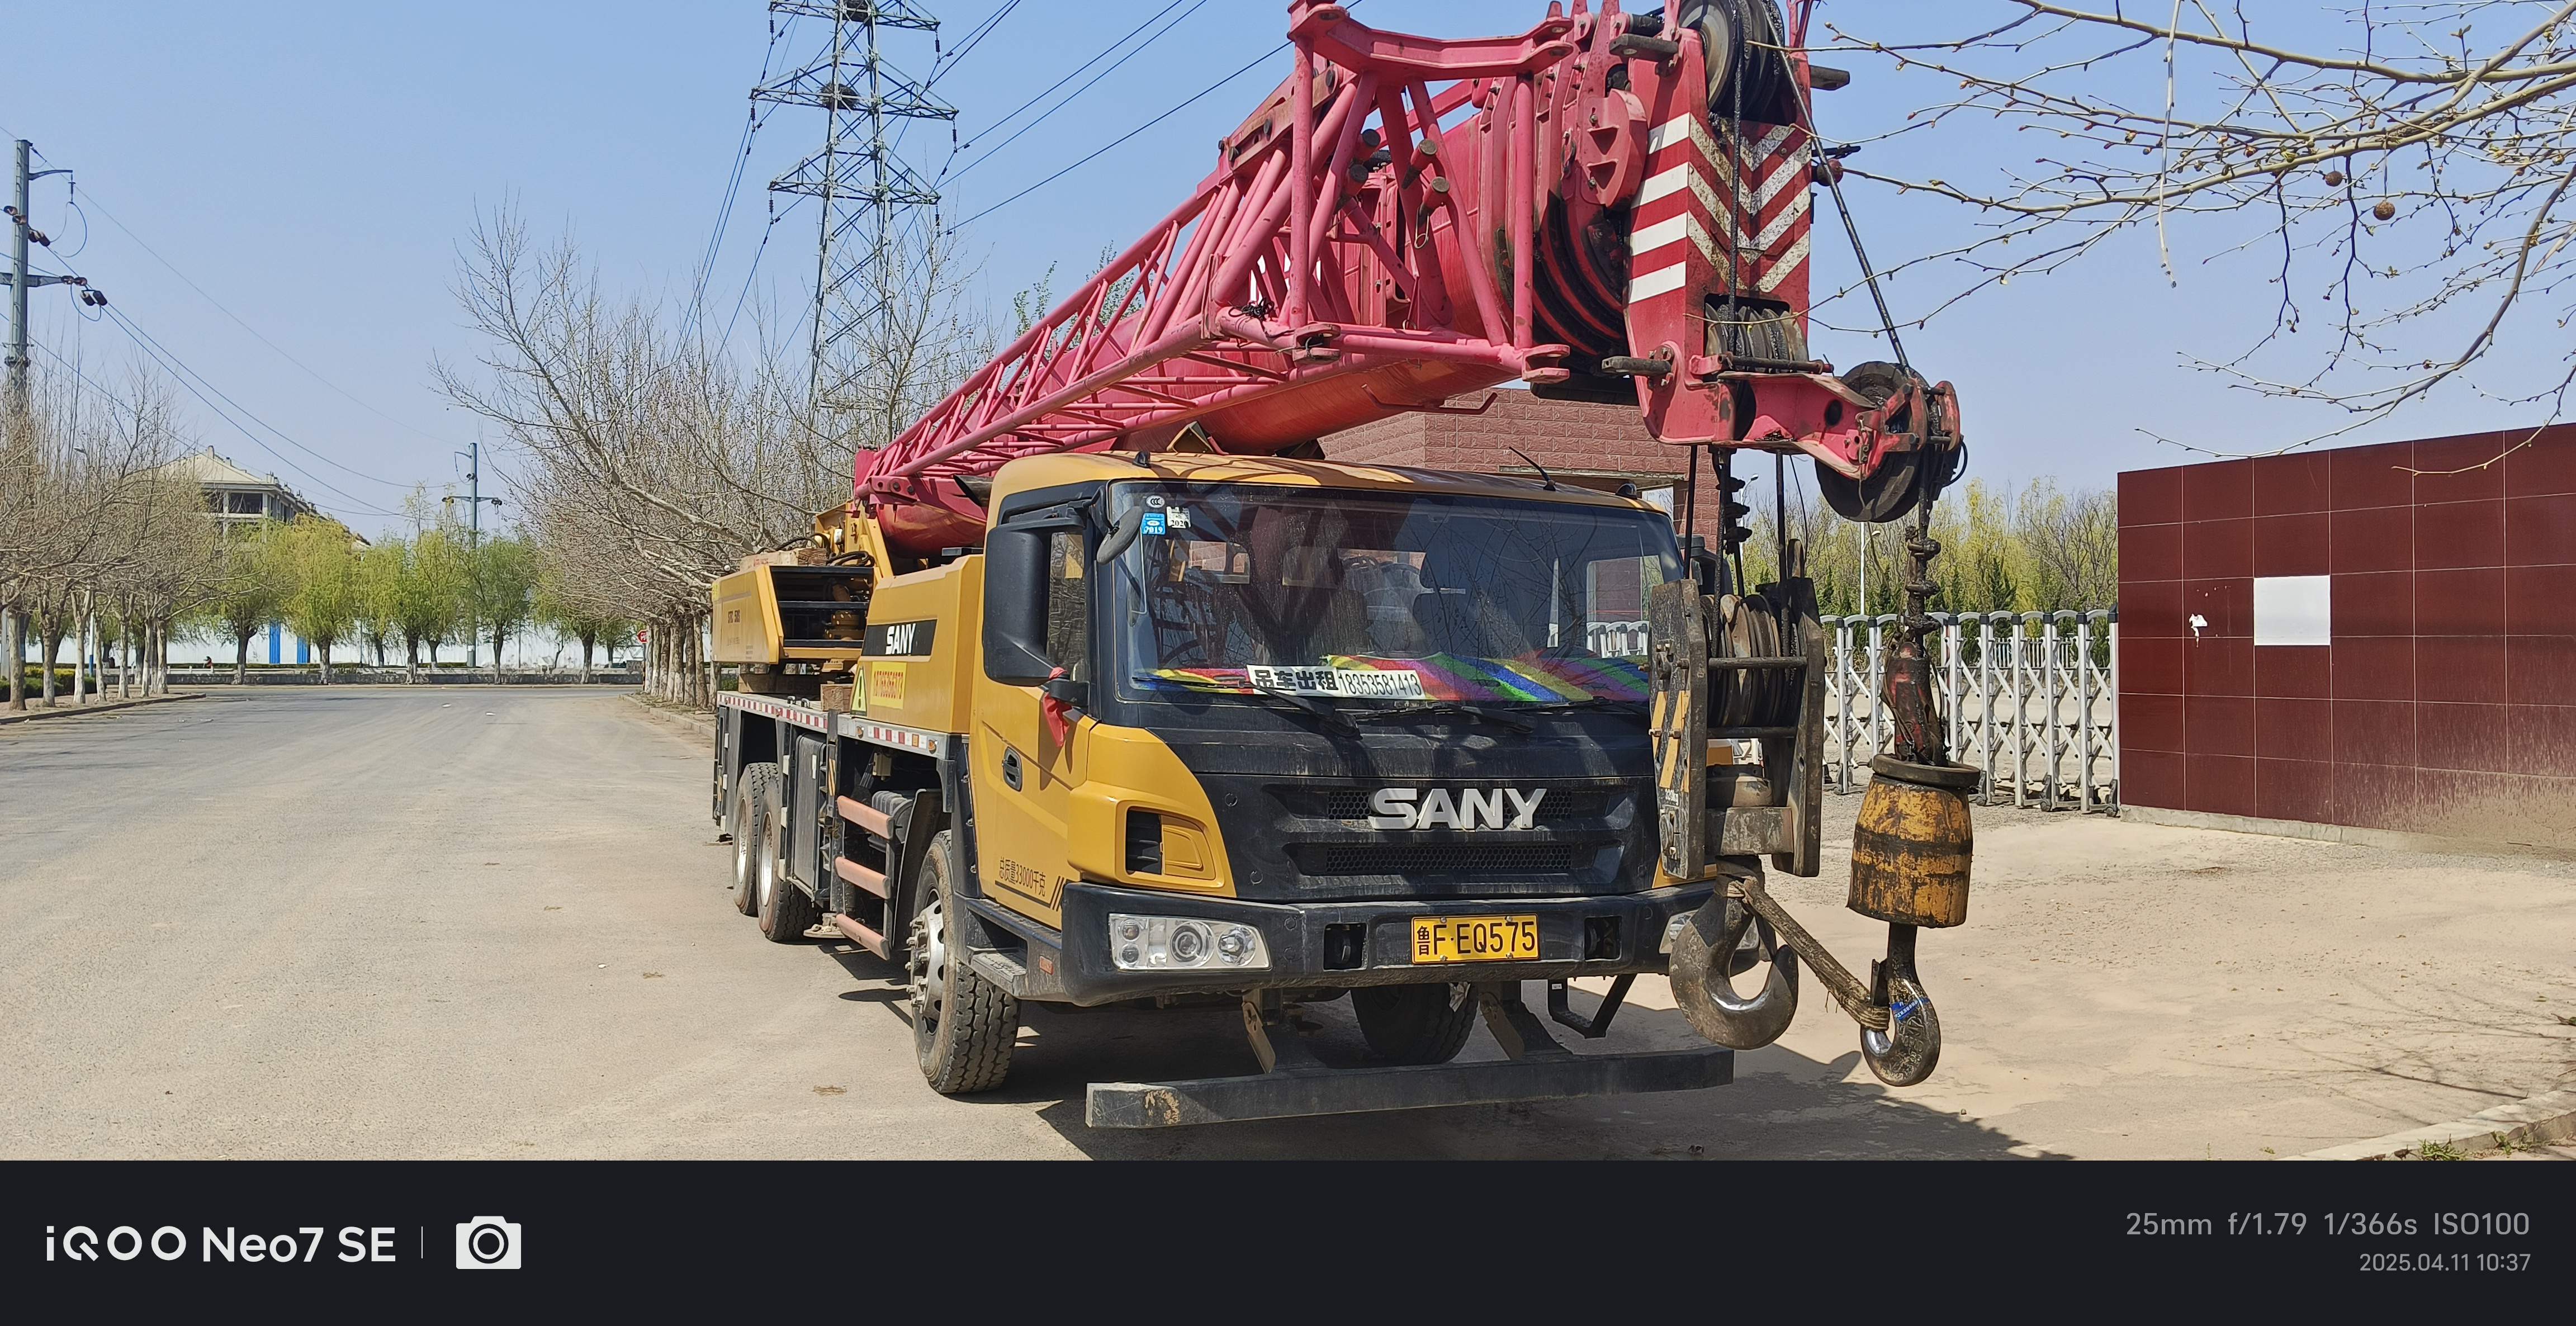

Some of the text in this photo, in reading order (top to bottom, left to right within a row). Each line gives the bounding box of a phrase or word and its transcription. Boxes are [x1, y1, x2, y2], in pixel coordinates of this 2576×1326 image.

[886, 623, 916, 654] SANY
[1254, 670, 1422, 696] 吊车出租 18353581413
[1367, 788, 1547, 830] SANY
[998, 856, 1046, 897] 总质量33000千克
